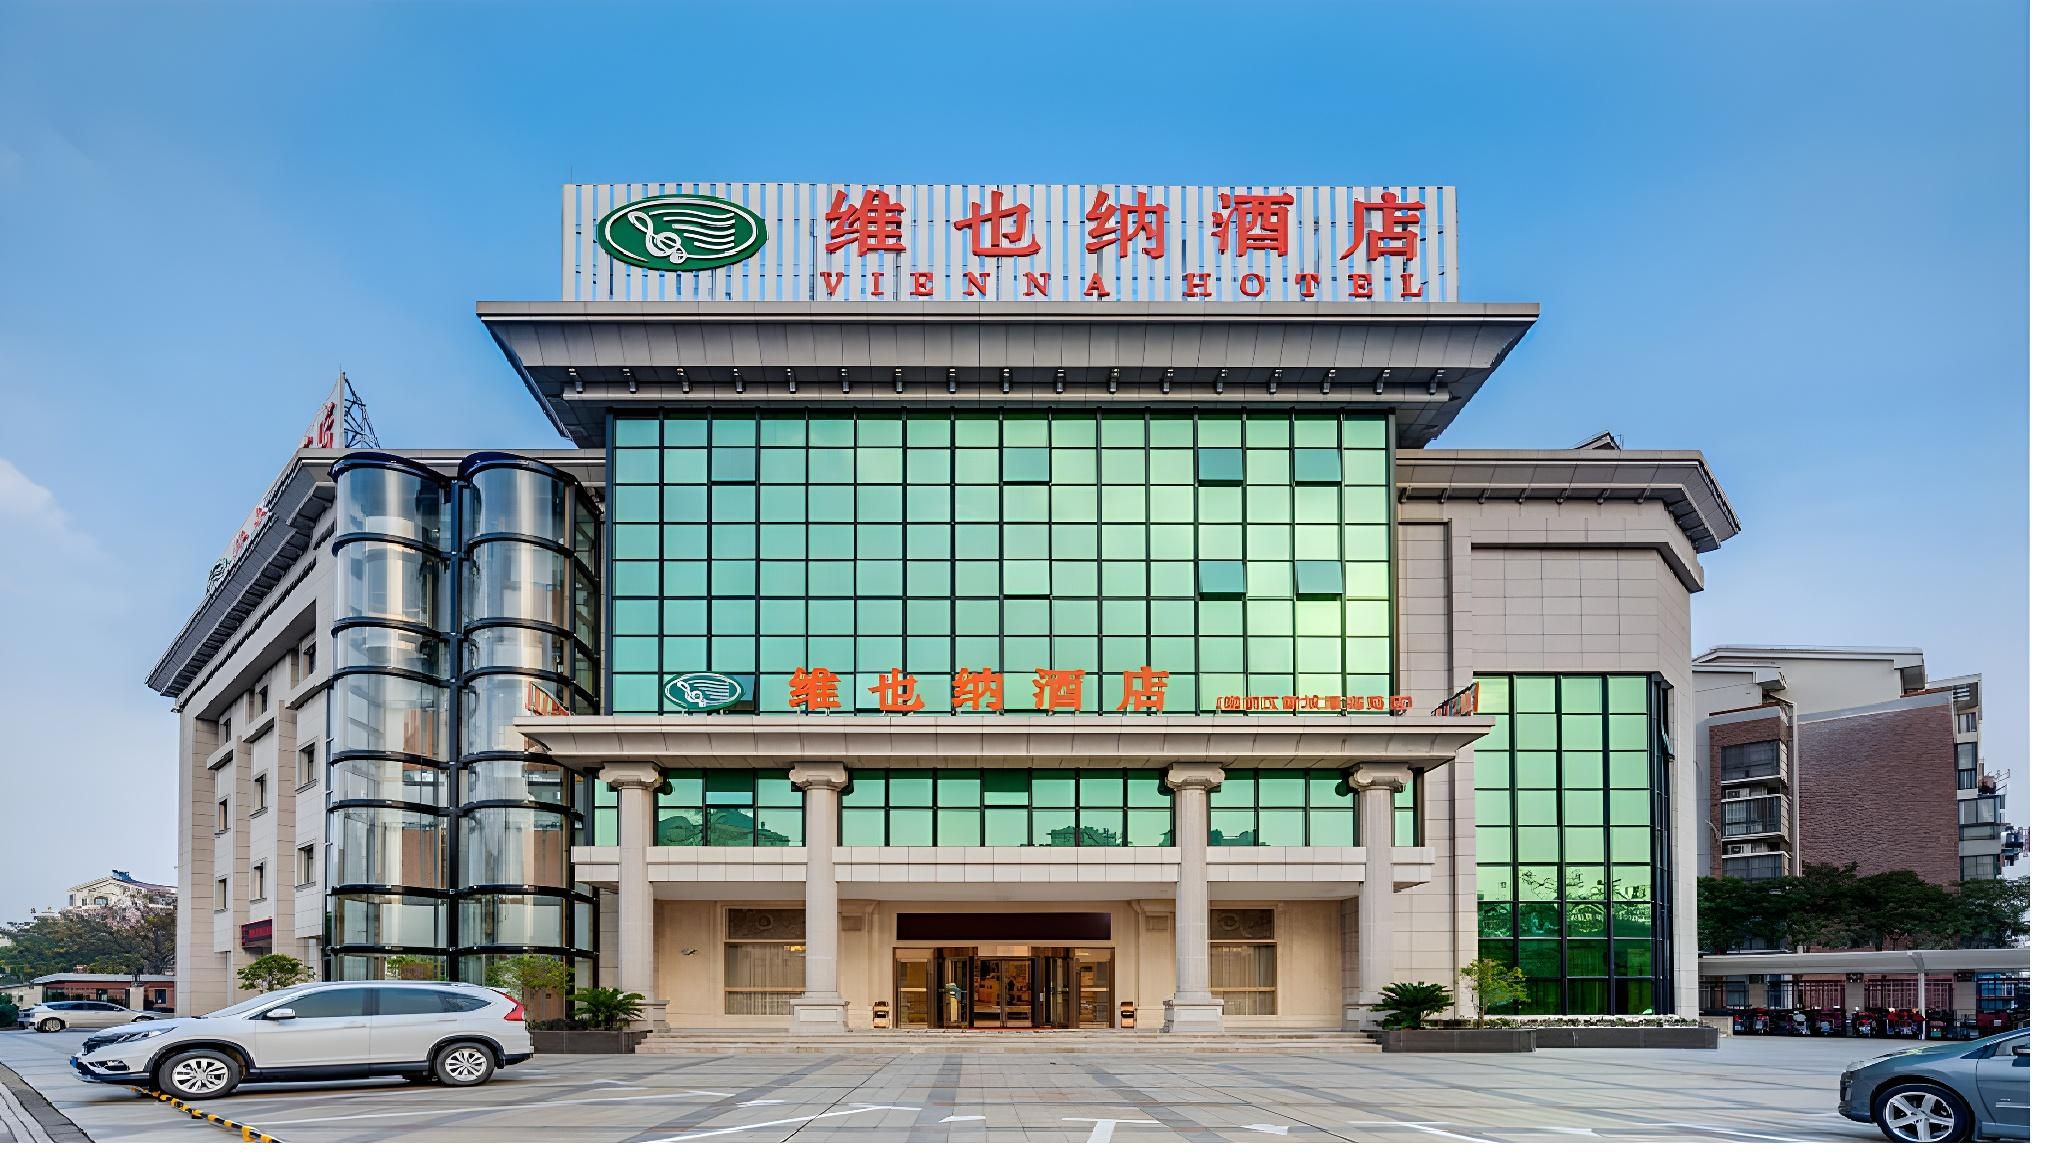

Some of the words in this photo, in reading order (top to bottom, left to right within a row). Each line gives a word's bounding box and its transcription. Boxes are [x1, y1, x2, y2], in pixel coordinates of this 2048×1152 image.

[824, 189, 1426, 261] 维也纳酒店
[820, 271, 1110, 298] VIENNA
[1183, 271, 1424, 298] HOTEL
[788, 666, 1171, 712] 维也纳酒店
